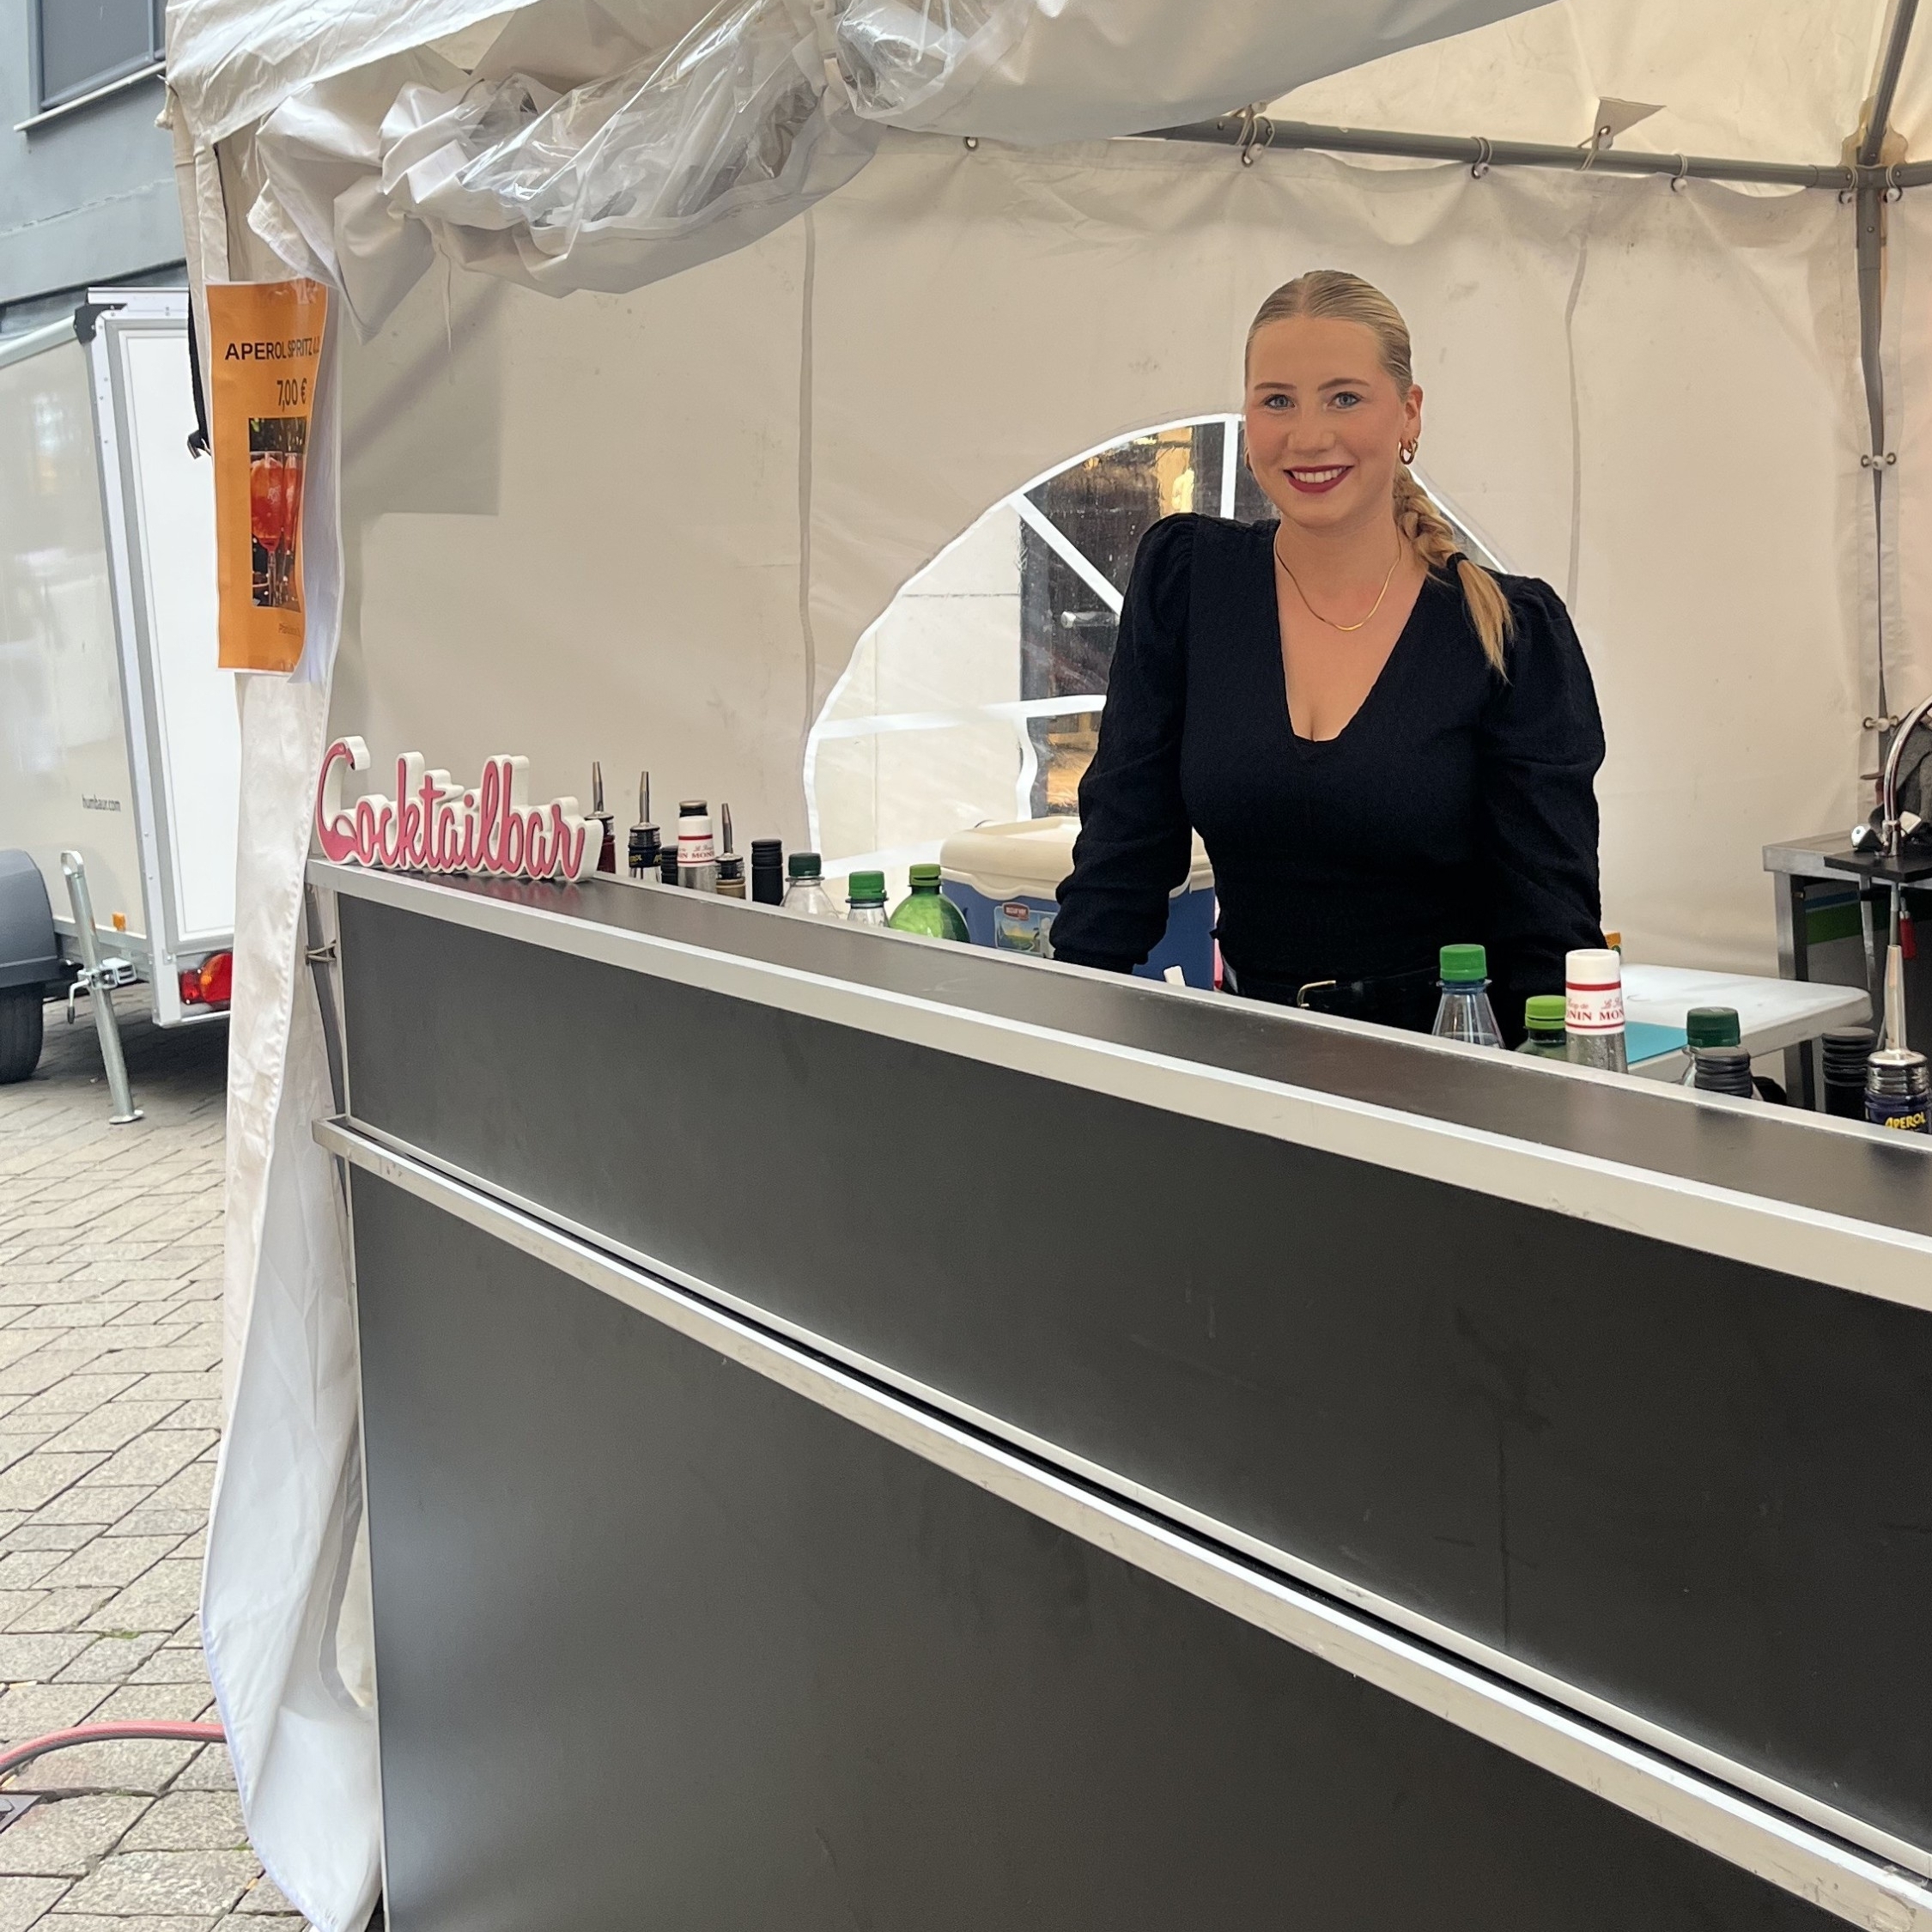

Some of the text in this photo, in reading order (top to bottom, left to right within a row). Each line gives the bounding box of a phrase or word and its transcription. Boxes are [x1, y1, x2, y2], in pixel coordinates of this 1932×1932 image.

[225, 341, 287, 361] APEROL
[287, 337, 313, 358] SPRITZ
[276, 378, 307, 412] 7,00 €
[82, 793, 121, 812] humbaur.com
[316, 736, 592, 883] Cocktailbar
[1884, 1111, 1926, 1129] APEROL
